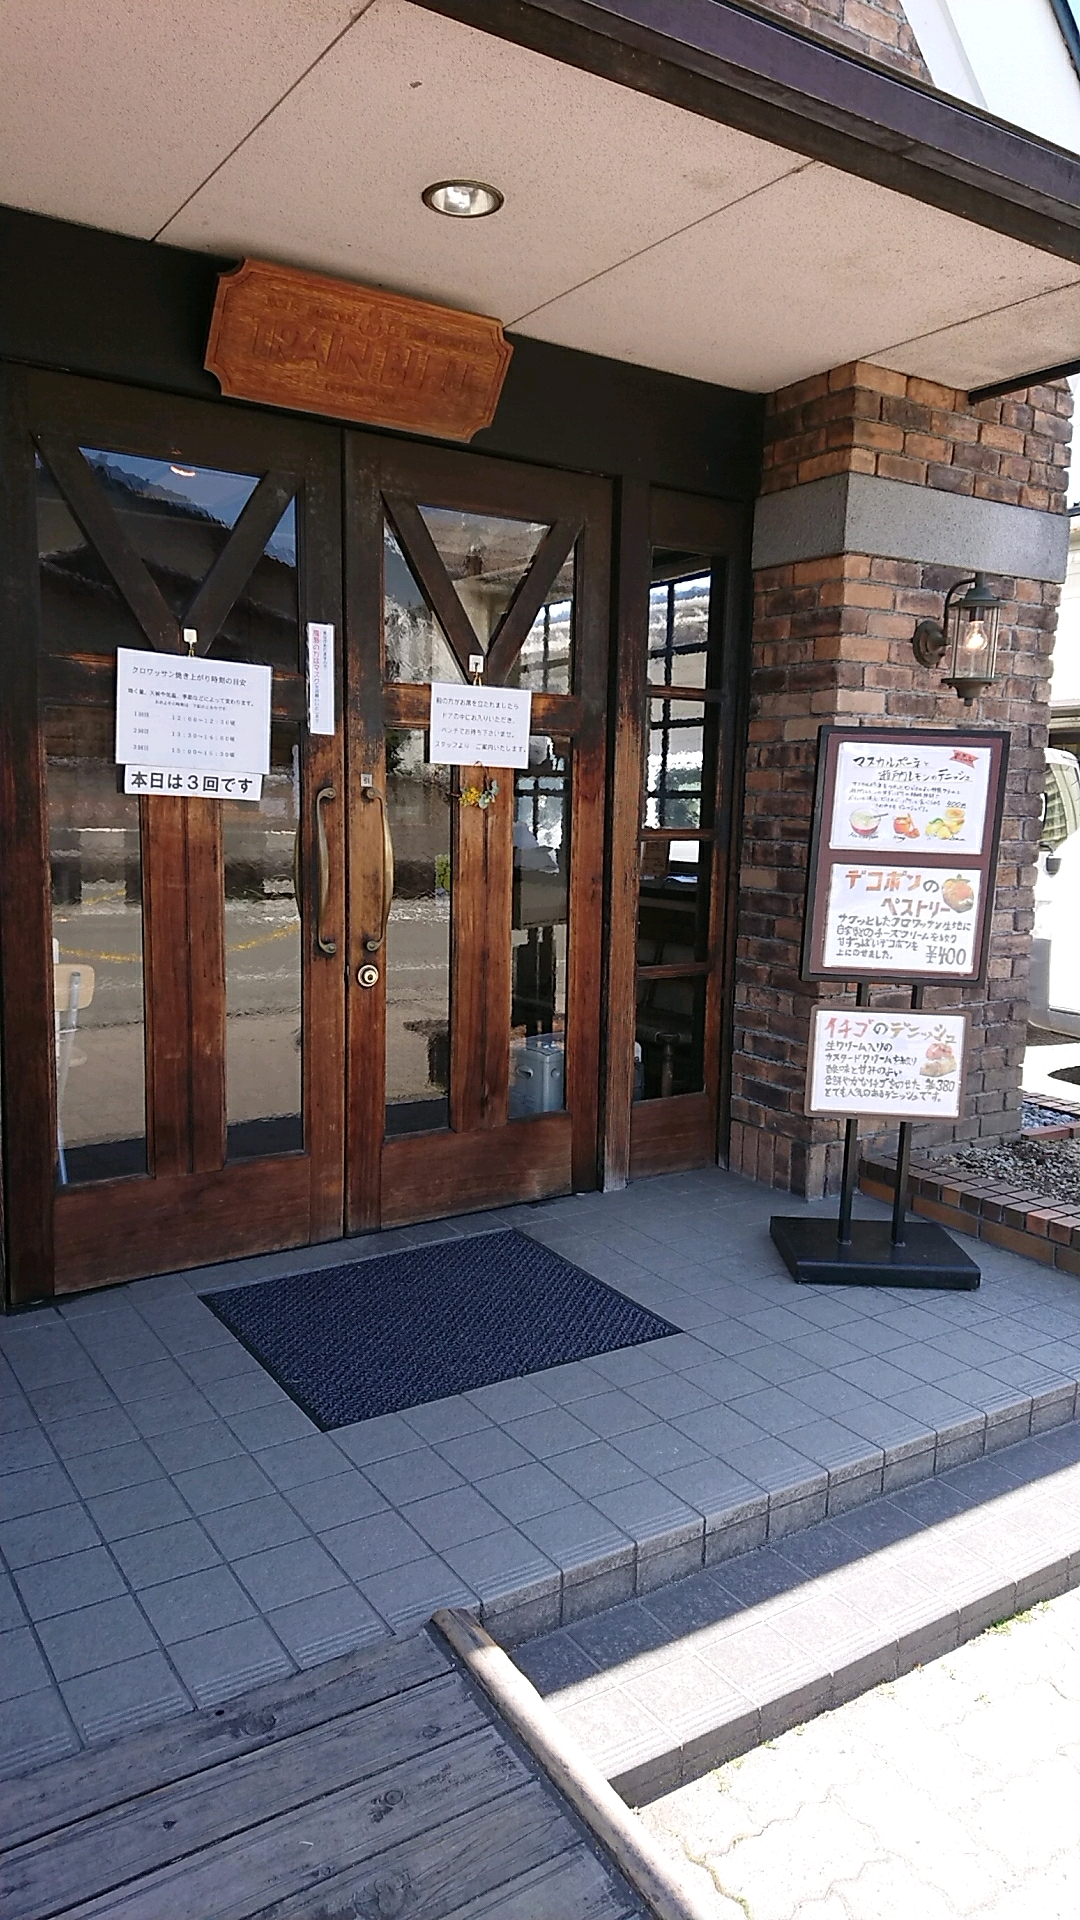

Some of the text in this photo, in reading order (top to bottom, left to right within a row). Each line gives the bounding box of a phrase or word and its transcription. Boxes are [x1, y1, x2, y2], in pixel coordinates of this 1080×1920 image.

[131, 666, 247, 687] クロワッサン焼き上がり時刻の目安
[434, 740, 470, 750] スタッフより
[852, 755, 930, 769] マスカルポーネと
[131, 770, 253, 794] 本日は3回です
[845, 869, 940, 894] デコポンの
[881, 897, 951, 918] ペストリー
[925, 945, 967, 966] ¥400
[824, 1017, 957, 1044] イチゴのデニッシュ
[825, 1041, 893, 1053] 生クリーム入りの
[824, 1087, 942, 1103] とても人気のあるデニッシュです。
